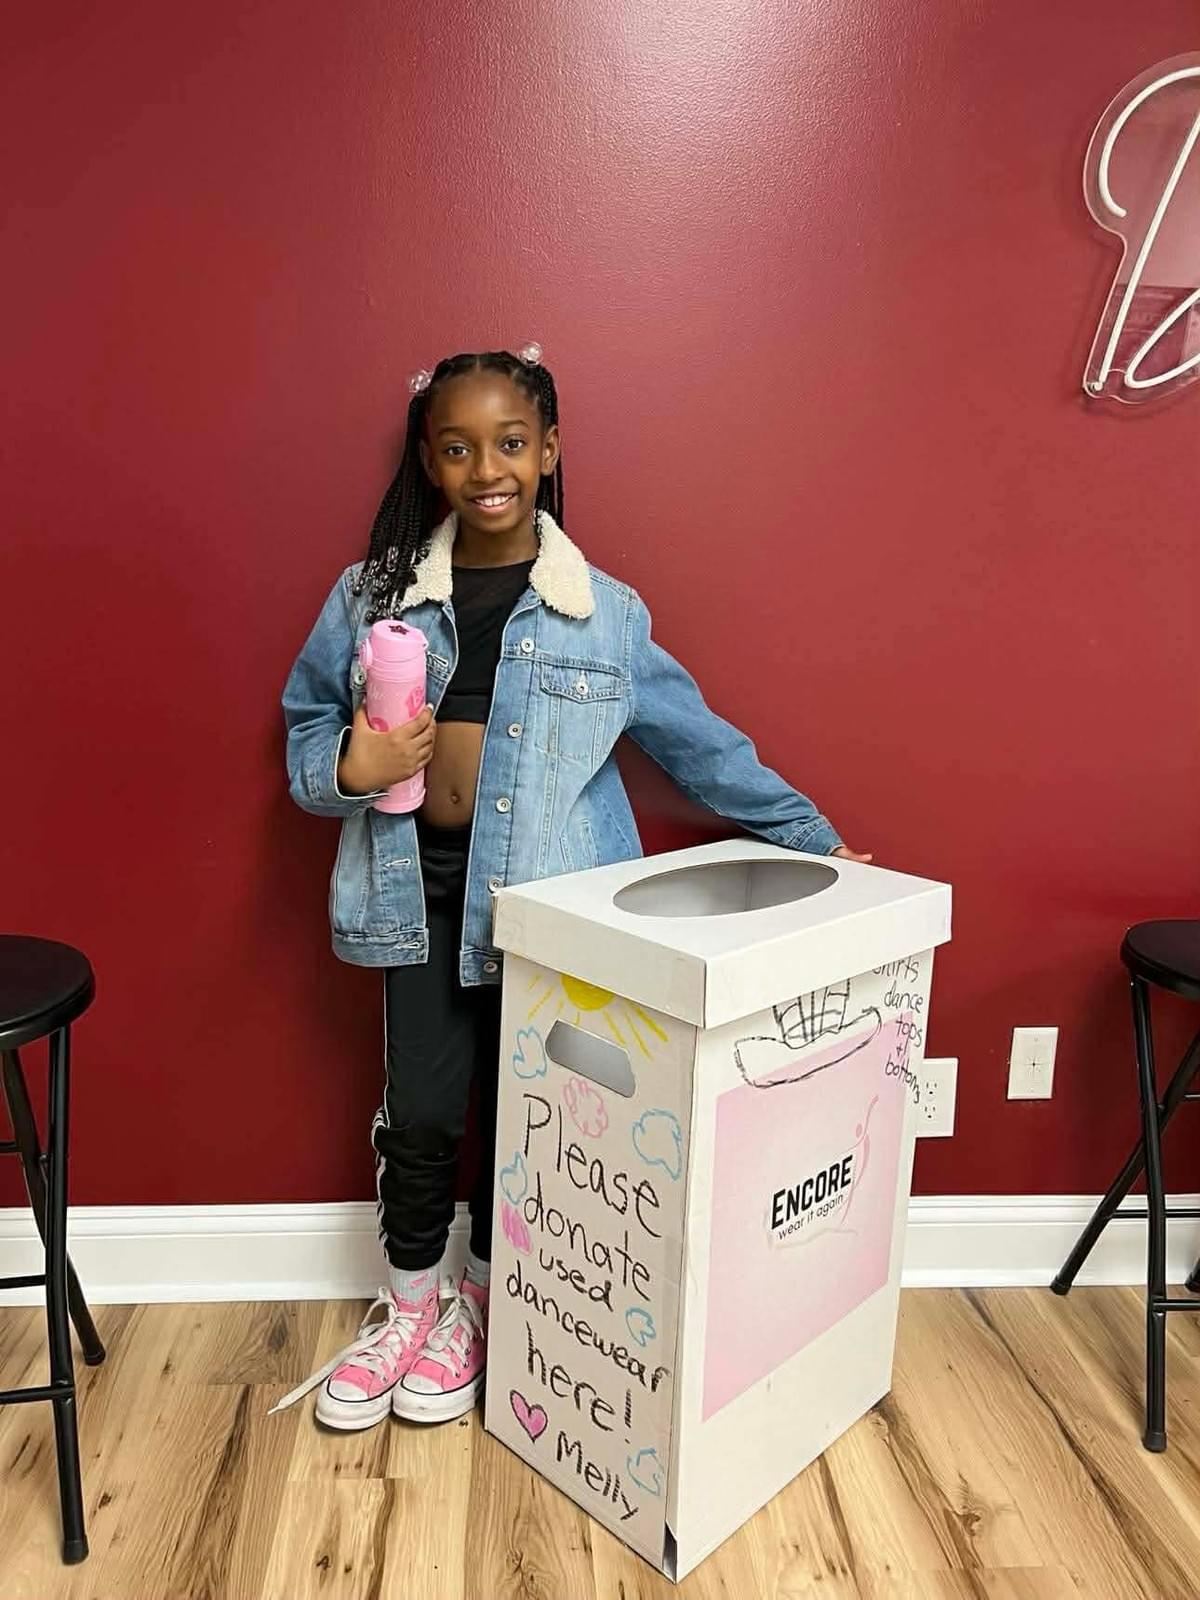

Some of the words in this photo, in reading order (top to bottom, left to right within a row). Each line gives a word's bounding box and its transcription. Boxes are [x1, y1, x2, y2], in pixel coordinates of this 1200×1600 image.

[884, 980, 924, 1014] dance
[896, 1013, 923, 1057] tops
[523, 1093, 662, 1238] Please
[771, 1154, 854, 1230] ENCORE
[523, 1171, 651, 1302] donate
[778, 1217, 805, 1240] wear
[807, 1209, 814, 1224] it
[816, 1193, 844, 1217] again
[539, 1247, 614, 1312] used
[506, 1259, 671, 1393] dancewear
[526, 1319, 634, 1444] here!
[556, 1430, 641, 1521] Melly
